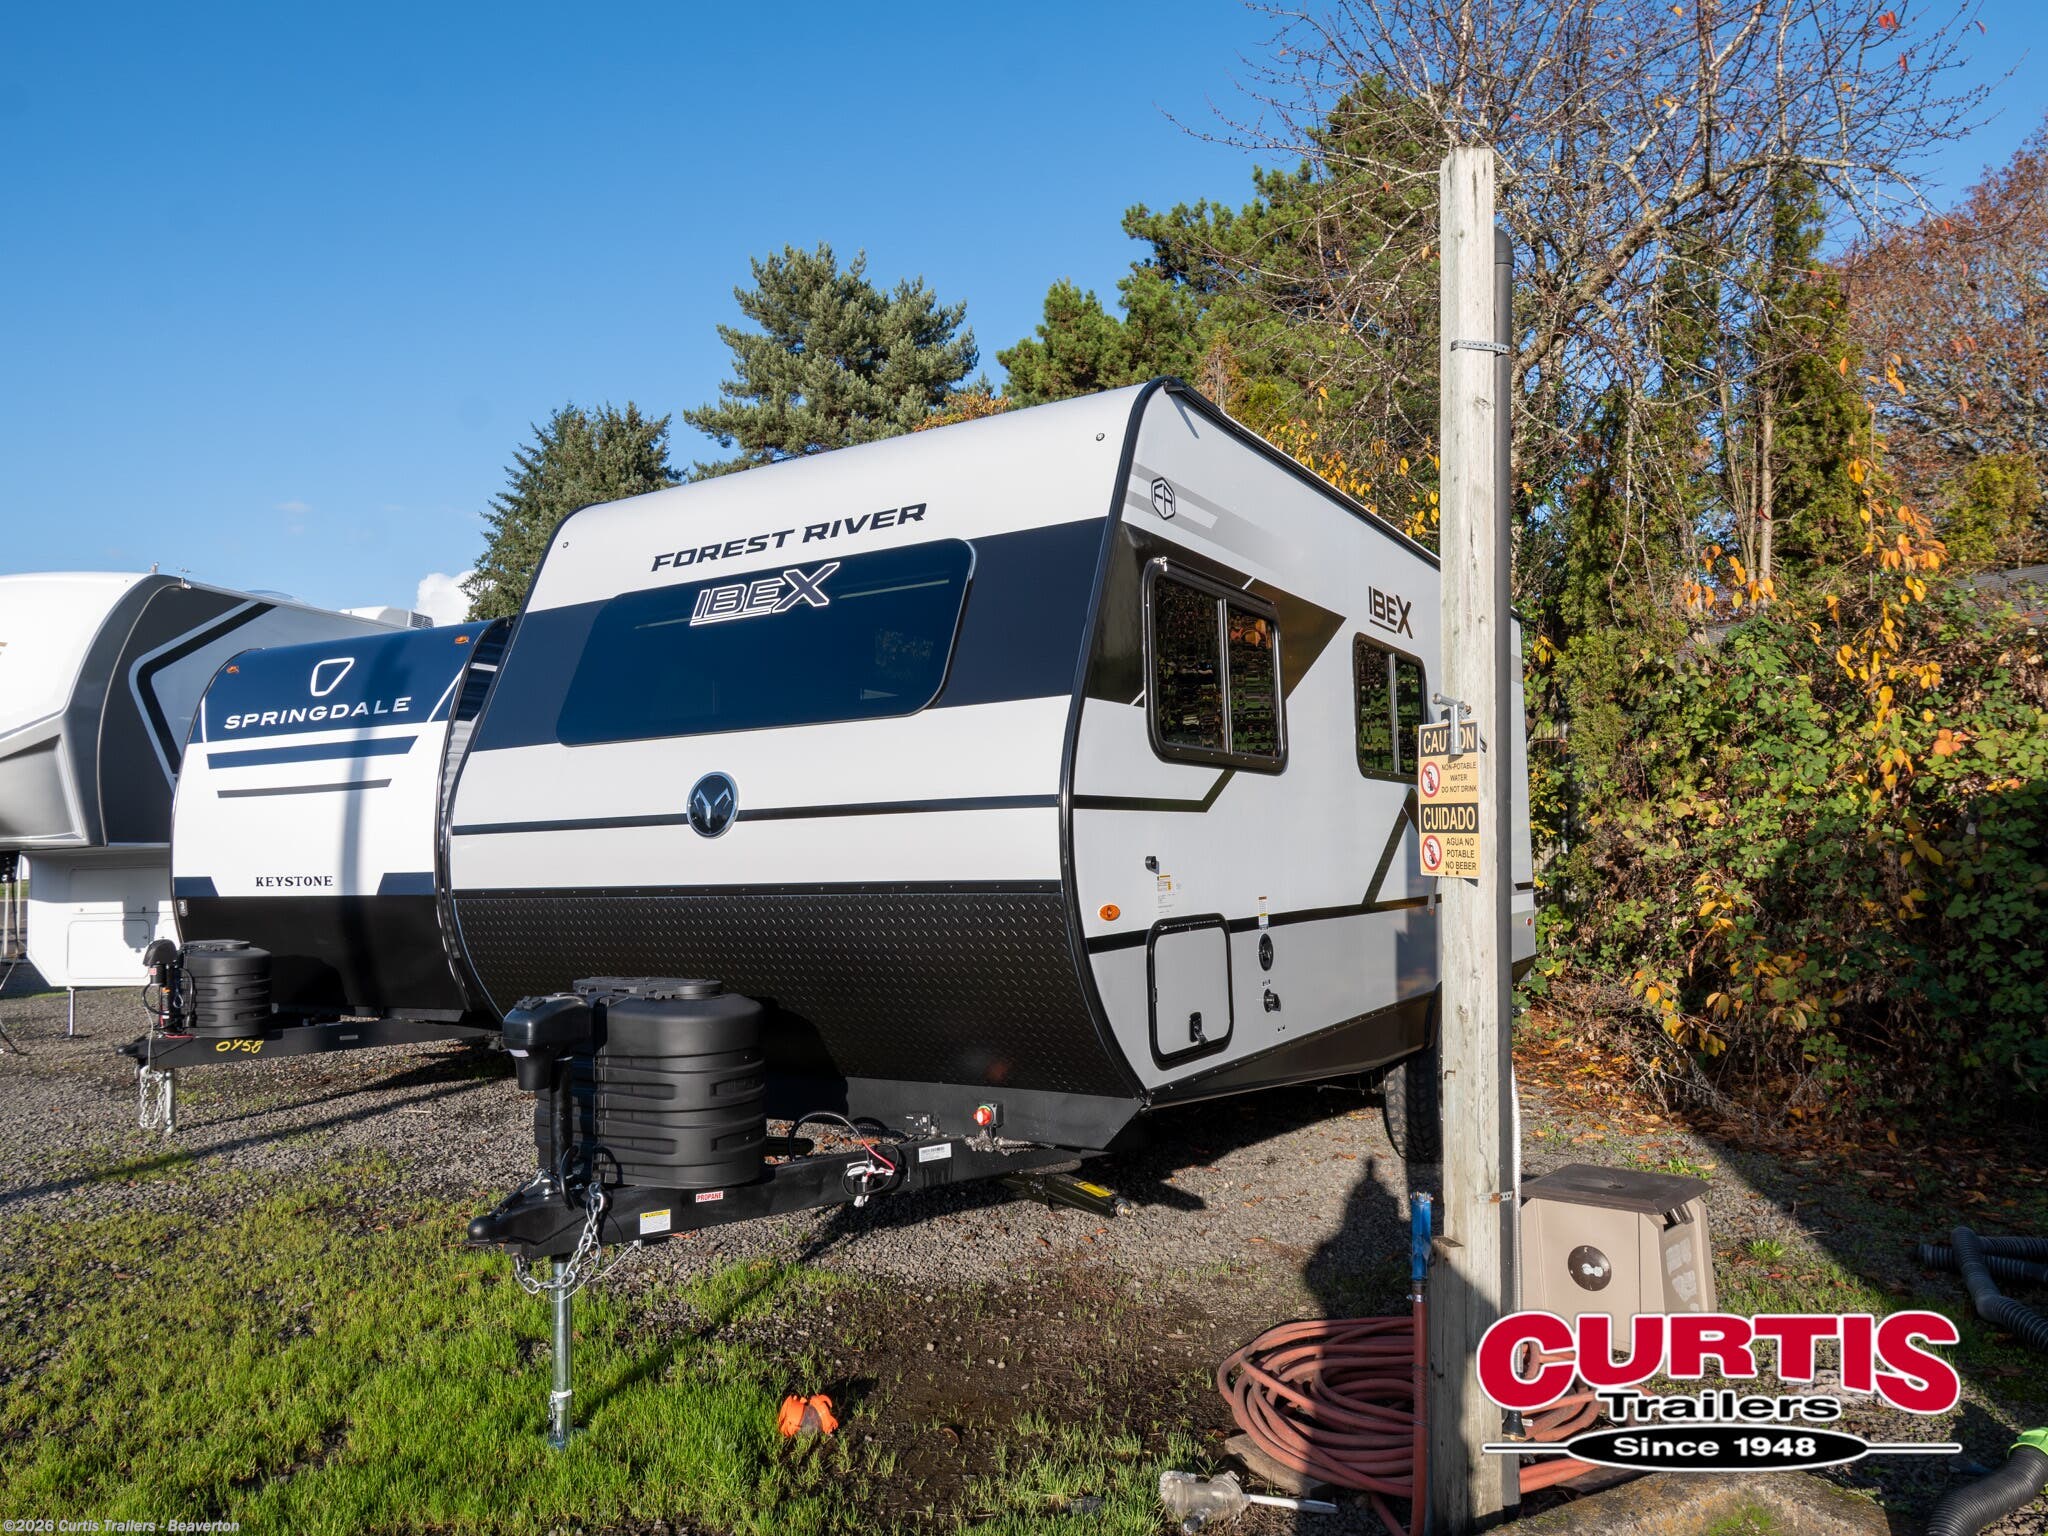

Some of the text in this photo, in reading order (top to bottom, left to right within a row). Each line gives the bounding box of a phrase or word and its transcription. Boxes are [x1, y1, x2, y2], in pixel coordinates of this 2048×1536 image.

[651, 503, 927, 572] FOREST RIVER
[690, 561, 840, 627] IBEX
[1368, 585, 1413, 640] IBEX
[224, 696, 412, 730] SPRINGDALE
[1423, 726, 1475, 754] CAUON
[1441, 762, 1477, 771] NON-POTABLE
[1449, 773, 1468, 782] WATER
[1441, 785, 1477, 794] DO NOT DRINK
[1423, 806, 1476, 831] CUIDADO
[1446, 837, 1475, 847] AGUA NO
[1446, 849, 1475, 859] POTABLE
[1445, 861, 1477, 871] NO BEBER
[255, 875, 334, 887] KEYSTONE
[696, 1191, 722, 1201] PROPANE
